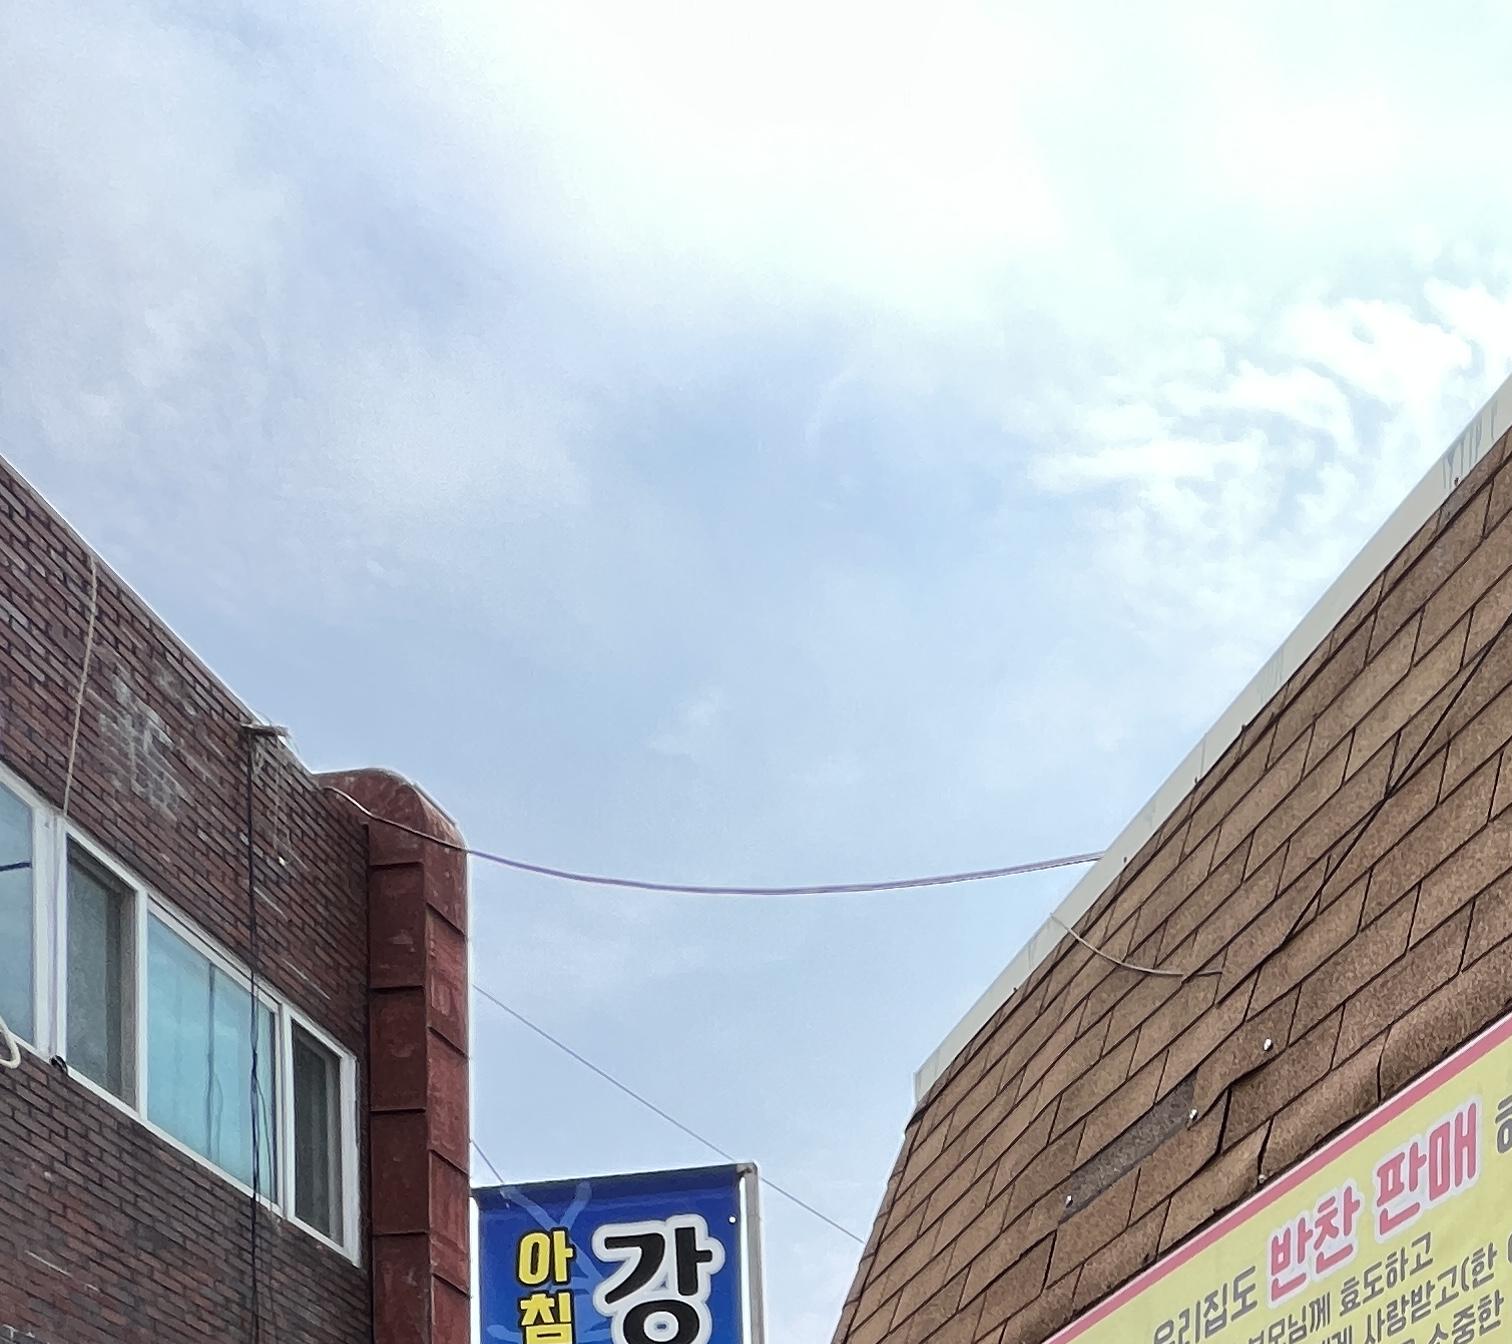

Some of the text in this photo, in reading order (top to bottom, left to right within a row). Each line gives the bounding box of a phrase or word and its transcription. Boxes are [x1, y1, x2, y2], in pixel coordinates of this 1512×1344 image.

[1271, 1186, 1361, 1301] 반찬
[1376, 1102, 1478, 1236] 판매
[1340, 1232, 1433, 1317] 효도하고
